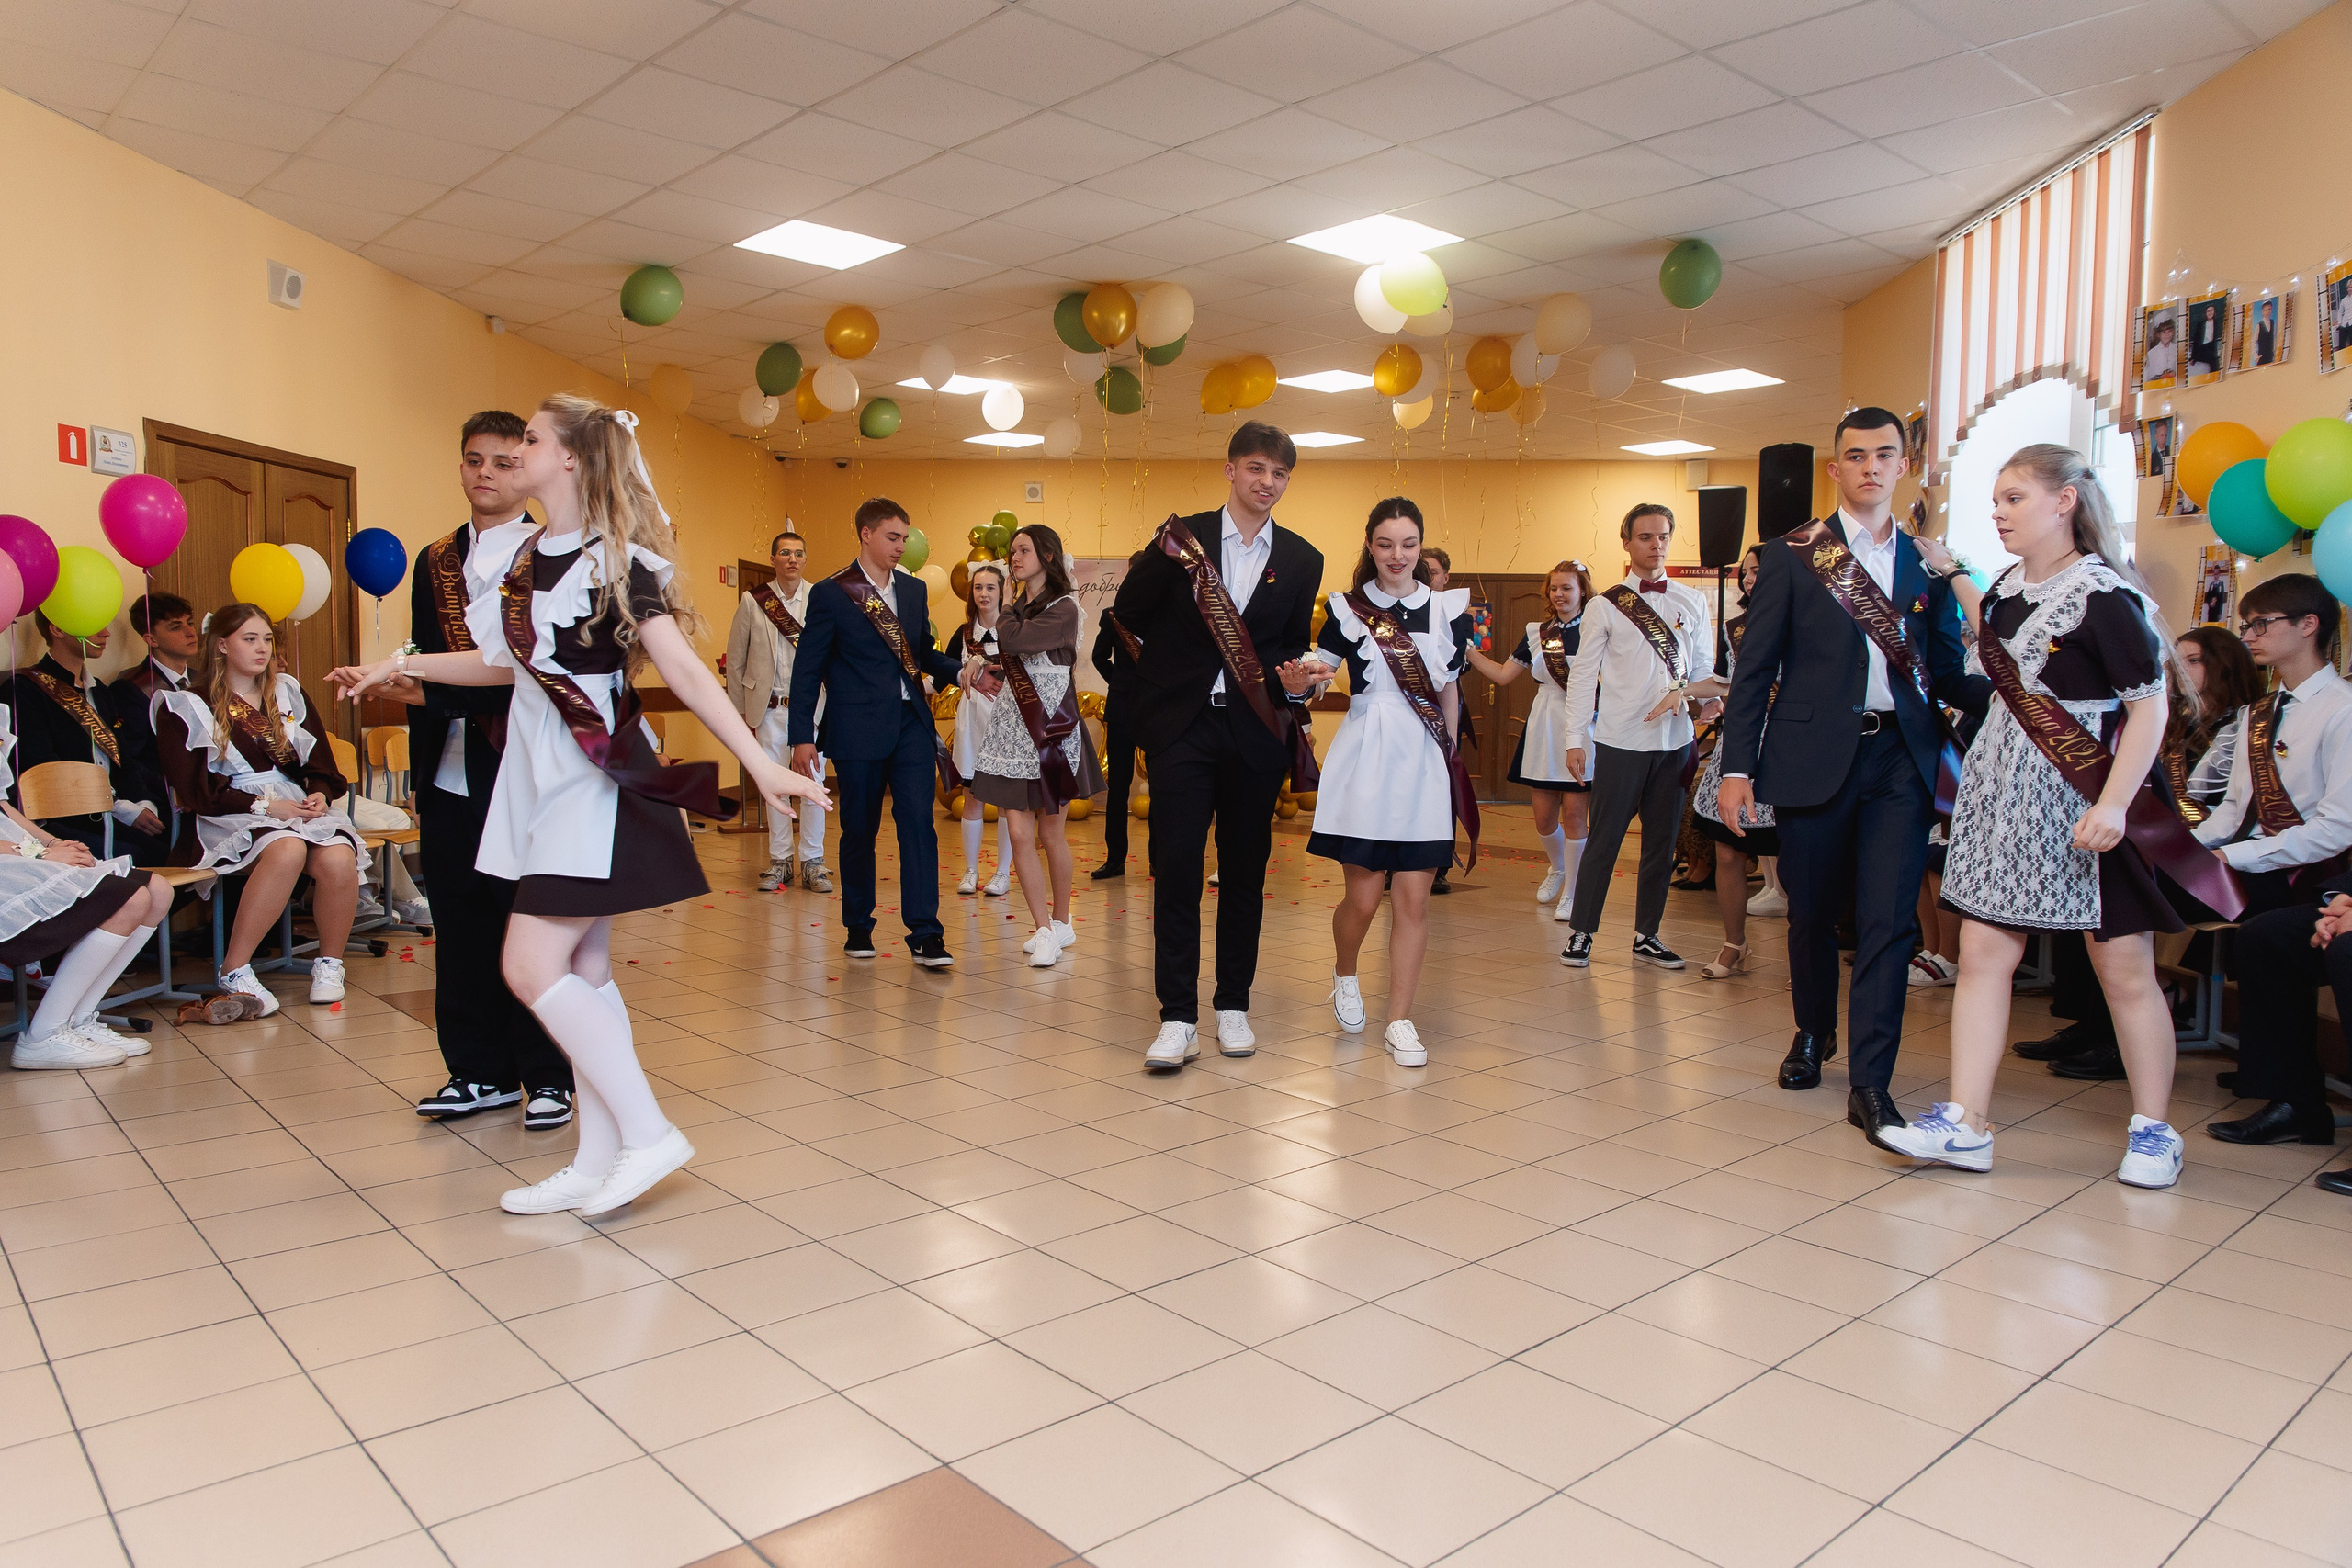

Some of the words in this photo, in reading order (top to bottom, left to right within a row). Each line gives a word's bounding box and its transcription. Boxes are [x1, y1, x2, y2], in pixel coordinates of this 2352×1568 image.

[1196, 561, 1244, 654] Выпускник
[1235, 652, 1265, 683] 2024
[1830, 561, 1912, 658] Выпускник
[1015, 681, 1038, 705] 2024
[1390, 636, 1437, 718] Выпускница
[1983, 630, 2061, 734] Выпускница
[2047, 727, 2107, 772] 2024
[58, 685, 119, 752] Выпускник
[2261, 791, 2301, 826] 2024
